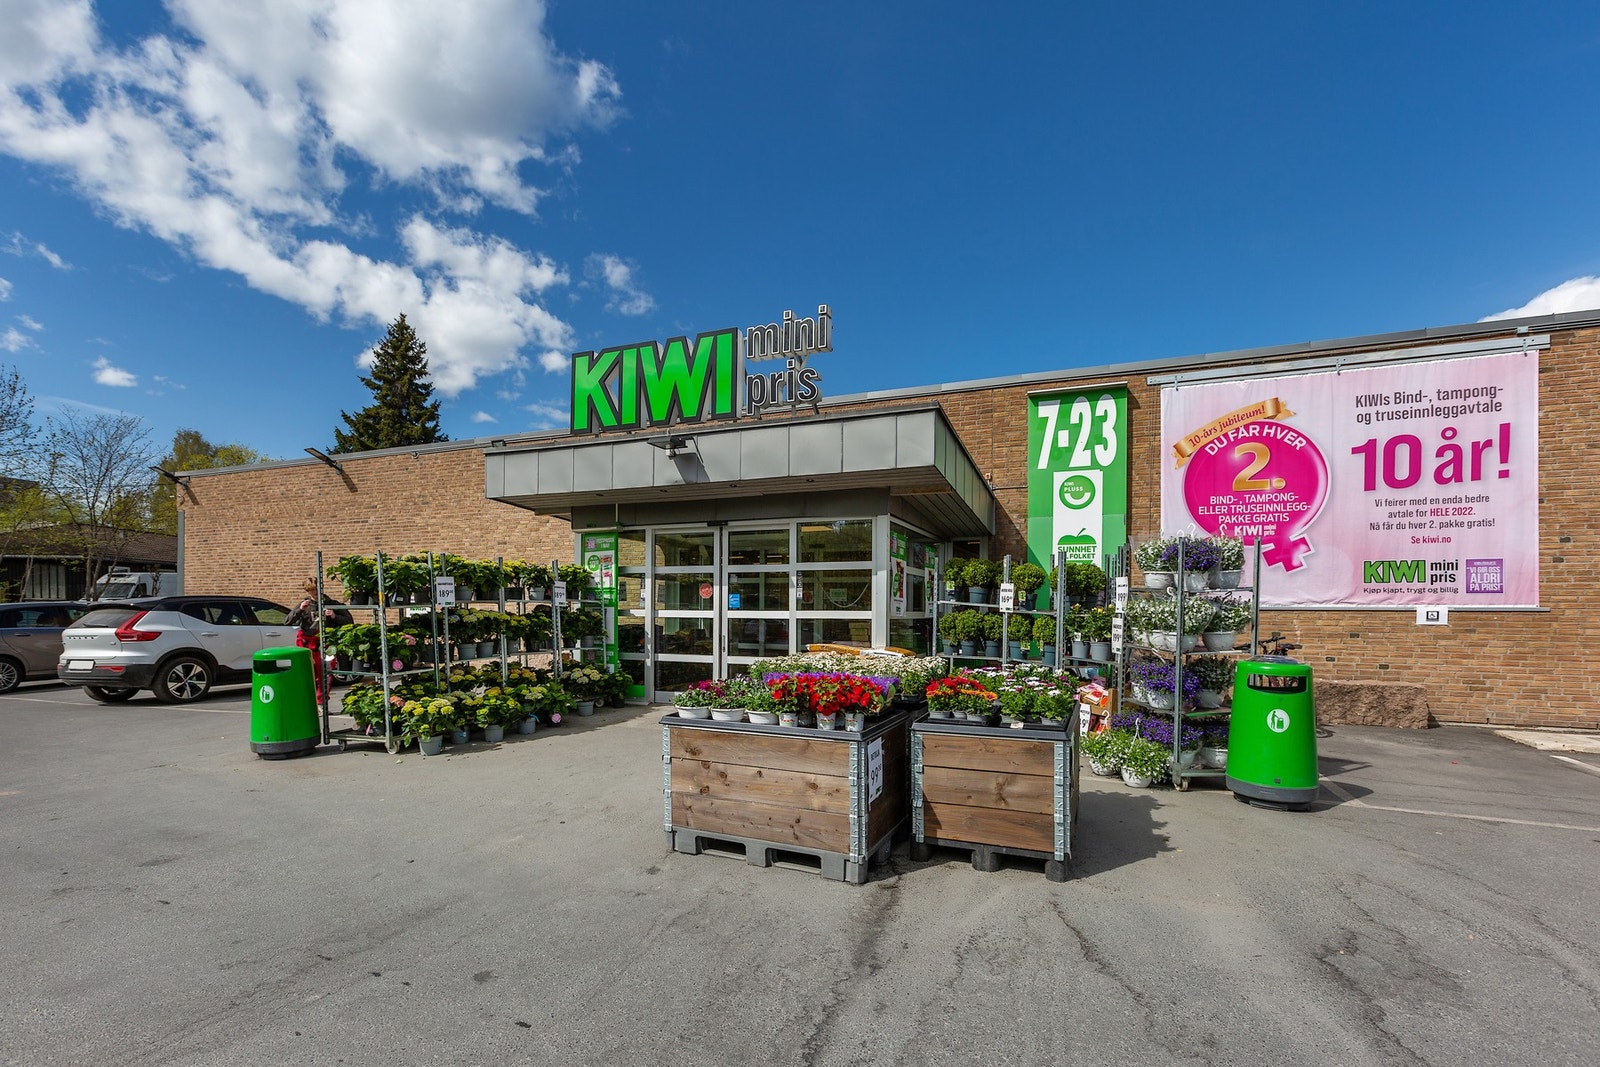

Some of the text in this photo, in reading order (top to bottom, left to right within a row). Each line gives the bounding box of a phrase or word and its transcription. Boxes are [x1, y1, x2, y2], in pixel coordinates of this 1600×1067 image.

[747, 304, 831, 361] mini
[571, 327, 741, 434] KIWI
[747, 359, 819, 416] pris
[1355, 385, 1503, 408] KIWIs Bind-, tampong-
[1356, 400, 1503, 425] og truseinnleggavtale
[1037, 393, 1118, 470] 7-23
[1188, 404, 1266, 448] 10-års jubileum!
[1204, 435, 1228, 456] DU
[1262, 424, 1308, 451] HVER
[1351, 422, 1511, 492] 10 år!
[1232, 441, 1286, 492] 2.
[1244, 492, 1299, 503] TAMPONG-
[1374, 494, 1490, 507] Vi feirer med en enda bedre
[1198, 502, 1311, 515] ELLER TRUSEINNLEGG-
[1388, 506, 1476, 519] avtale for HELE 2022.
[1218, 513, 1290, 524] PAKKE GRATIS
[1369, 518, 1495, 531] Nå får du hver 2. pakke gratis!
[1234, 525, 1263, 537] KIWI
[1410, 535, 1452, 544] Se kiwi.no
[1058, 545, 1097, 553] SUNNHET
[1363, 560, 1426, 583] KIWI
[1430, 559, 1459, 571] mini
[1430, 571, 1457, 586] pris
[1470, 573, 1501, 584] ALDRI
[1363, 587, 1381, 595] Kjøp
[1383, 587, 1405, 595] kjapt,
[1407, 587, 1426, 595] trygt
[1440, 586, 1459, 595] billig
